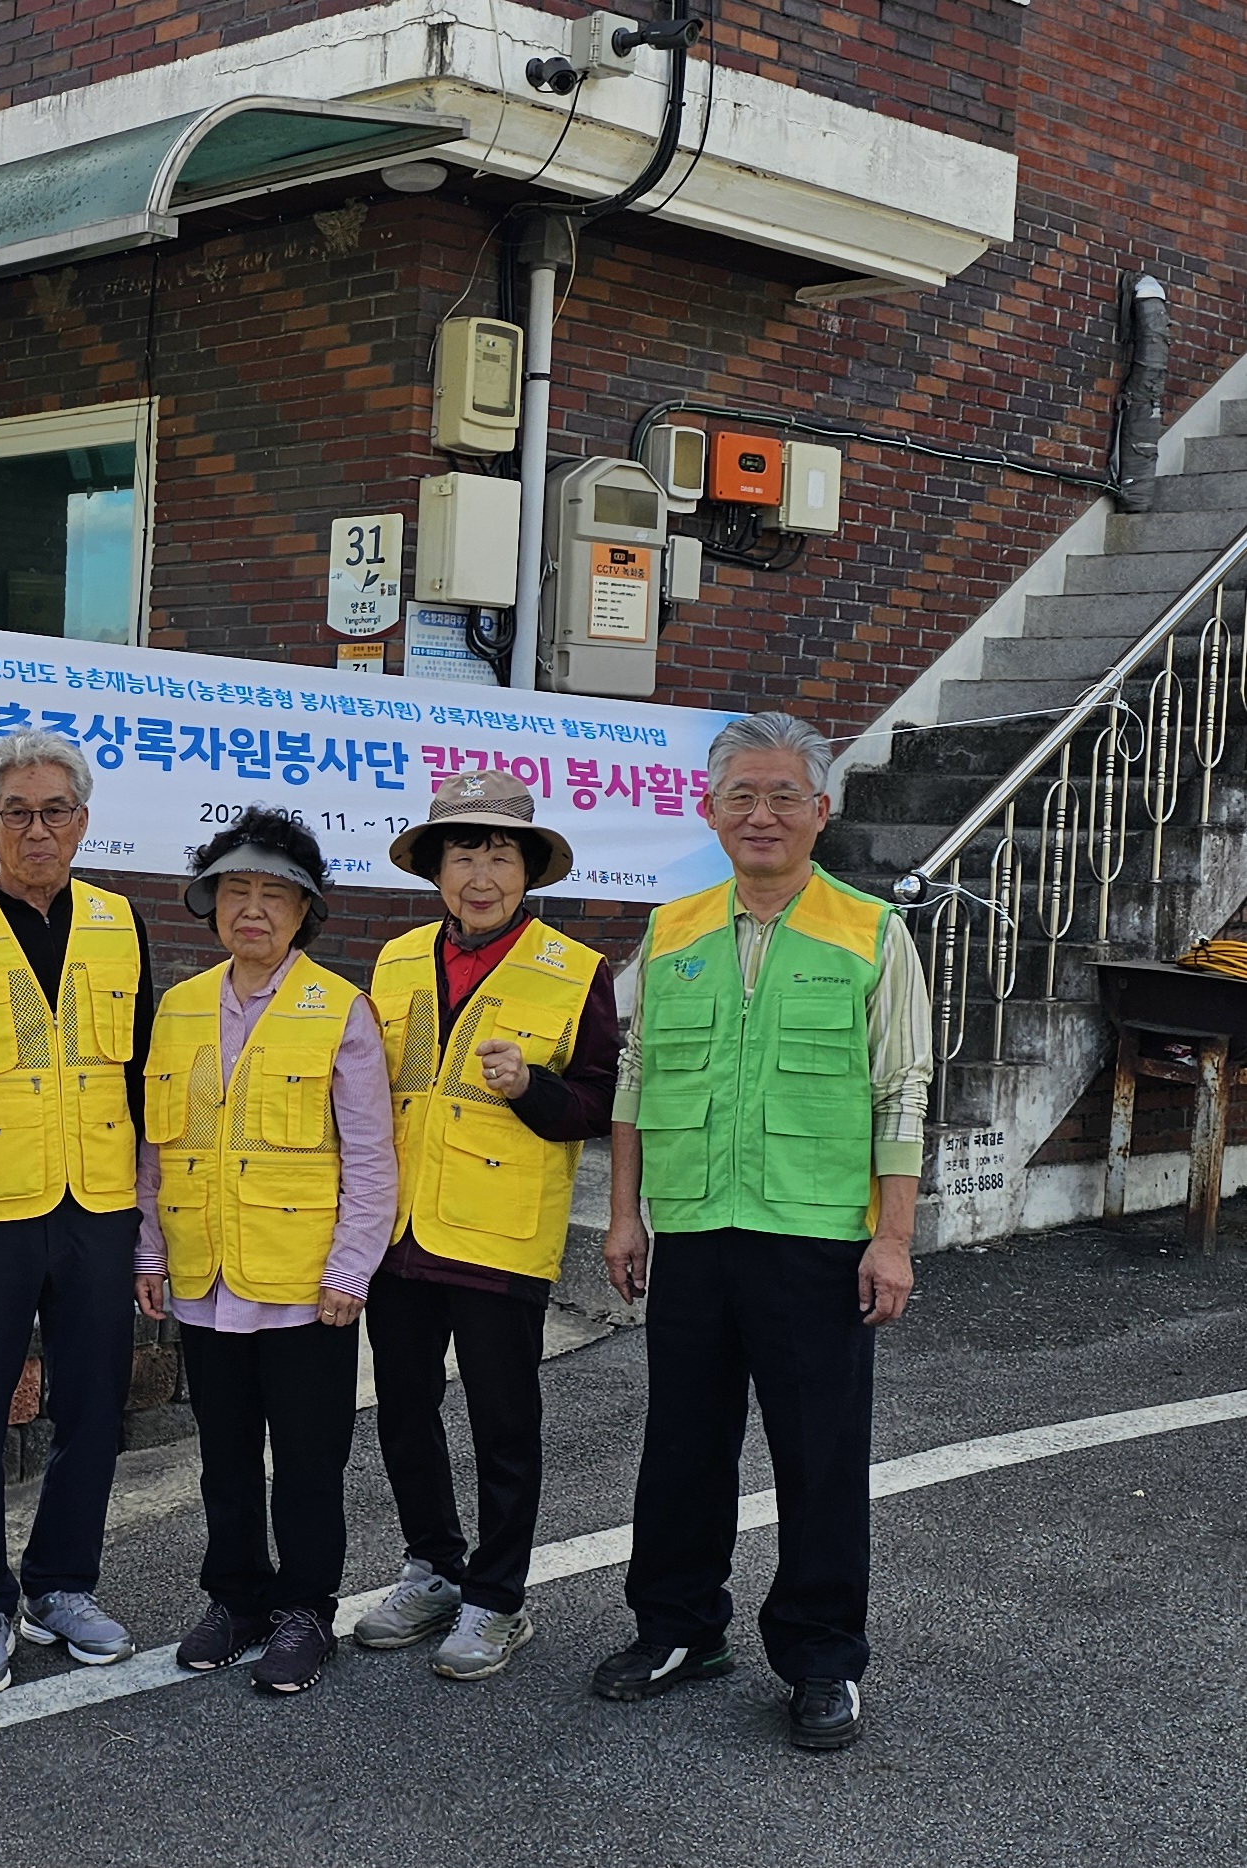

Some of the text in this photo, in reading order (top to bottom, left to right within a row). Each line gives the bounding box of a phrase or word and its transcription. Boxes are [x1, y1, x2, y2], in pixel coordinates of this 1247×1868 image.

[346, 525, 386, 566] 31
[596, 564, 645, 579] CCTV 녹화중
[65, 666, 294, 709] 농촌재능나눔(농촌맞춤형
[299, 691, 422, 722] 봉사활동지원)
[429, 705, 556, 735] 상록자원봉사단
[560, 718, 668, 747] 활동지원사업
[321, 811, 355, 833] 11.
[586, 870, 659, 887] 세종대전지부
[946, 1173, 1004, 1196] T.855-8888
